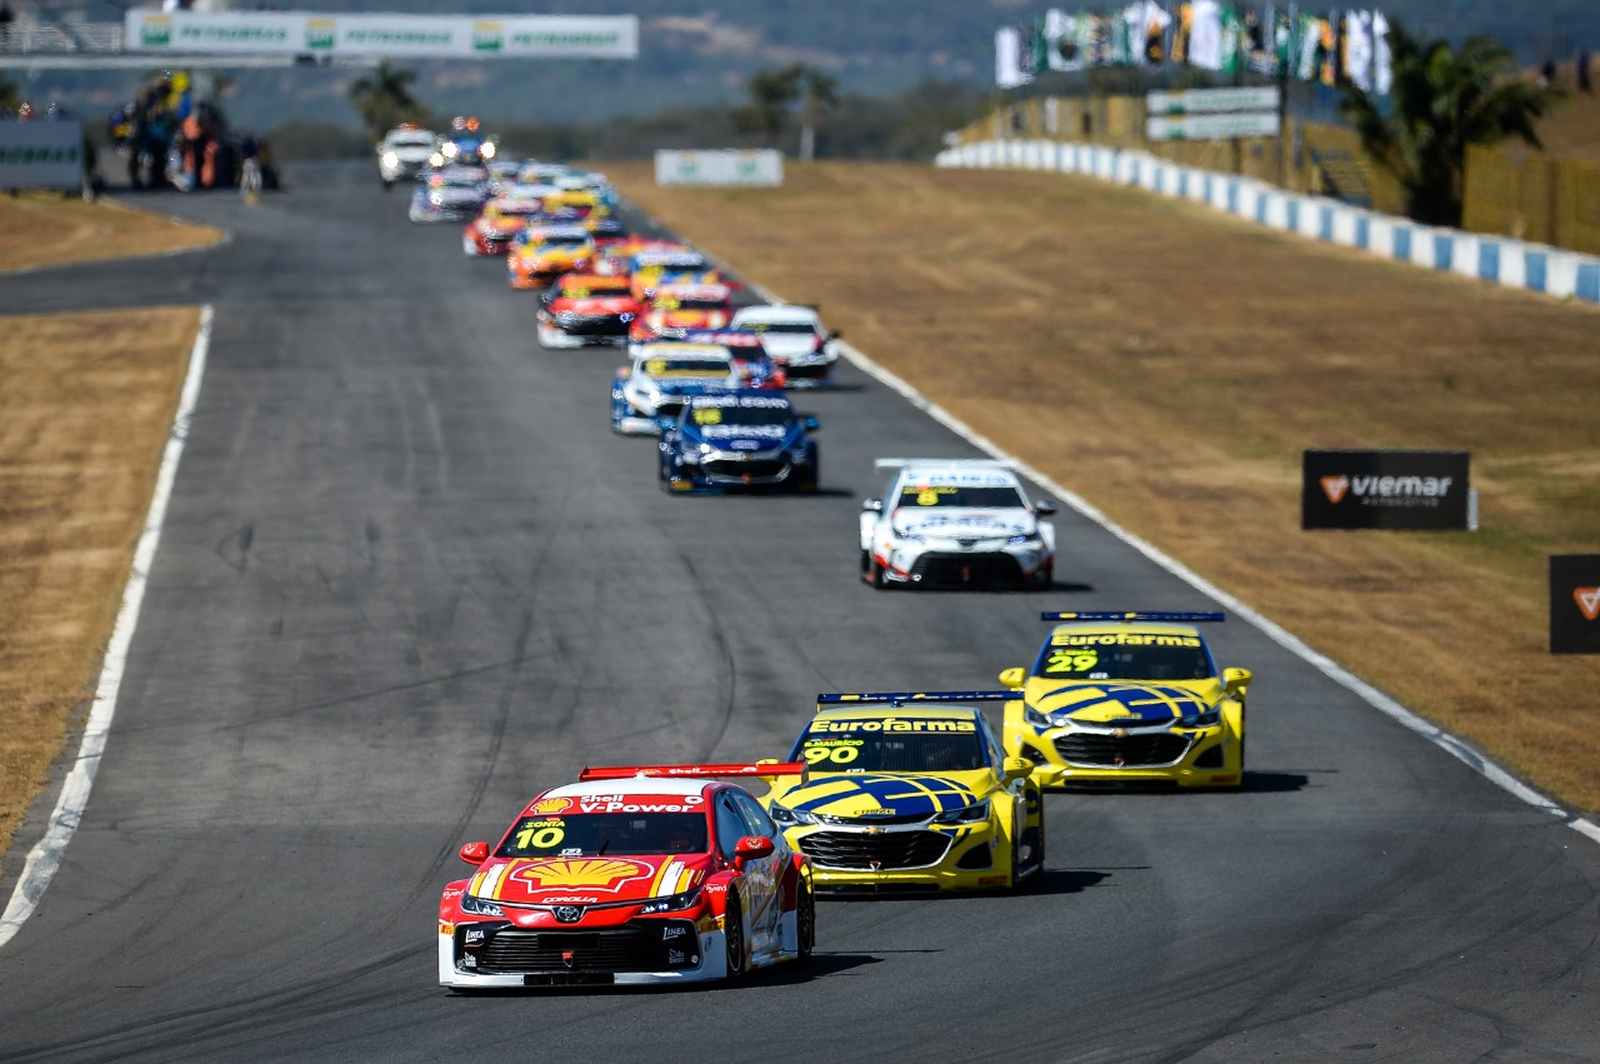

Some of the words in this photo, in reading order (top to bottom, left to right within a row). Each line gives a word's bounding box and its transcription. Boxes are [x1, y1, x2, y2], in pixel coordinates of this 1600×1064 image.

[1050, 633, 1201, 648] Eurofarma
[1046, 655, 1098, 673] 29
[808, 718, 977, 733] Eurofarma
[804, 746, 859, 765] 90
[580, 794, 625, 804] Shell
[579, 802, 695, 813] V-Power
[525, 820, 566, 829] ZONTA
[515, 826, 566, 849] 10
[541, 896, 598, 904] COROLLA
